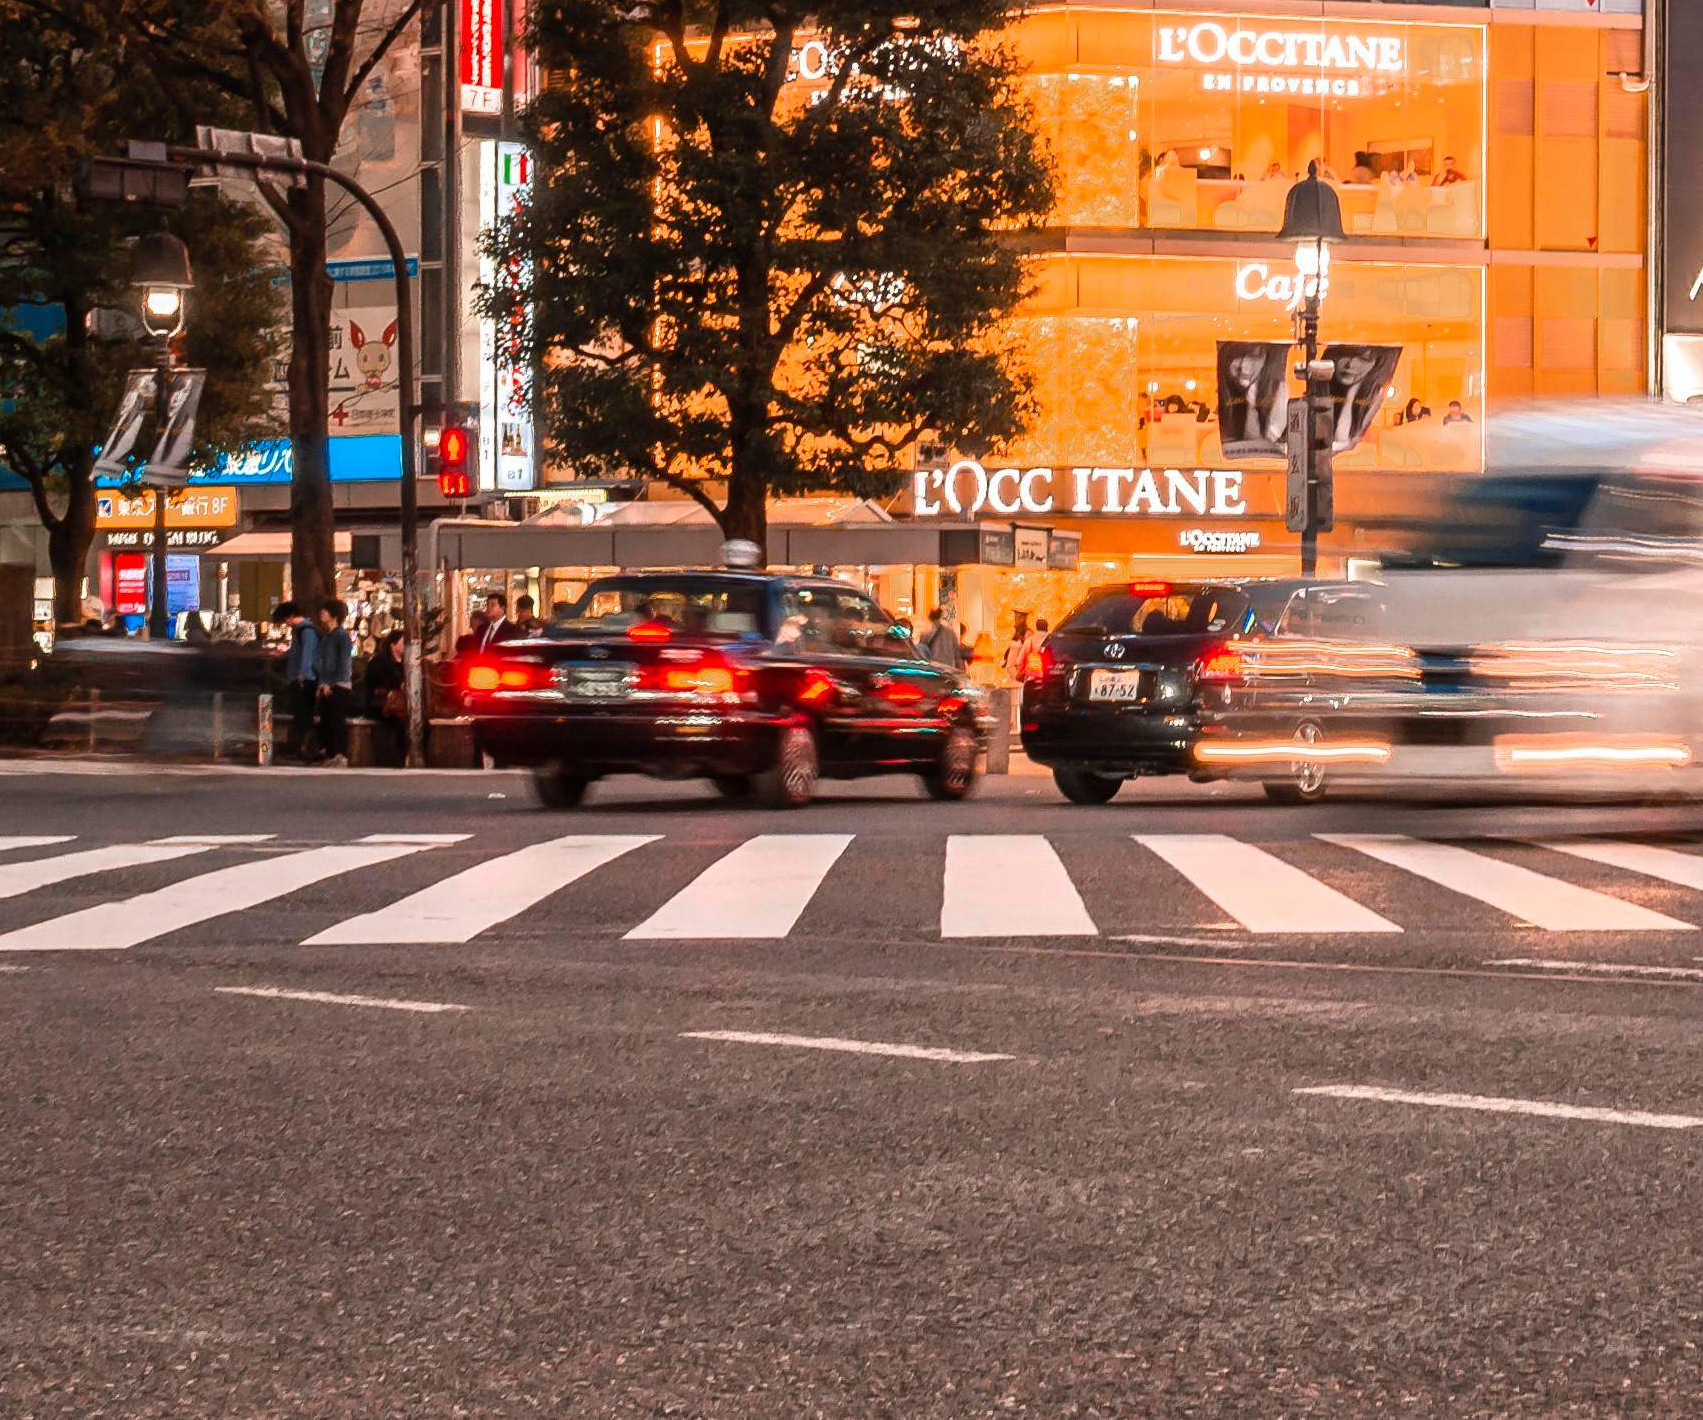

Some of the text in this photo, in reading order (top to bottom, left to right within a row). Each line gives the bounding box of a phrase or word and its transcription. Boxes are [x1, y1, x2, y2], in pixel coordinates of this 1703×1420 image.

[1156, 21, 1405, 71] L'OCCITANE
[1201, 73, 1360, 96] EN PROVENCE
[470, 89, 493, 108] 7F
